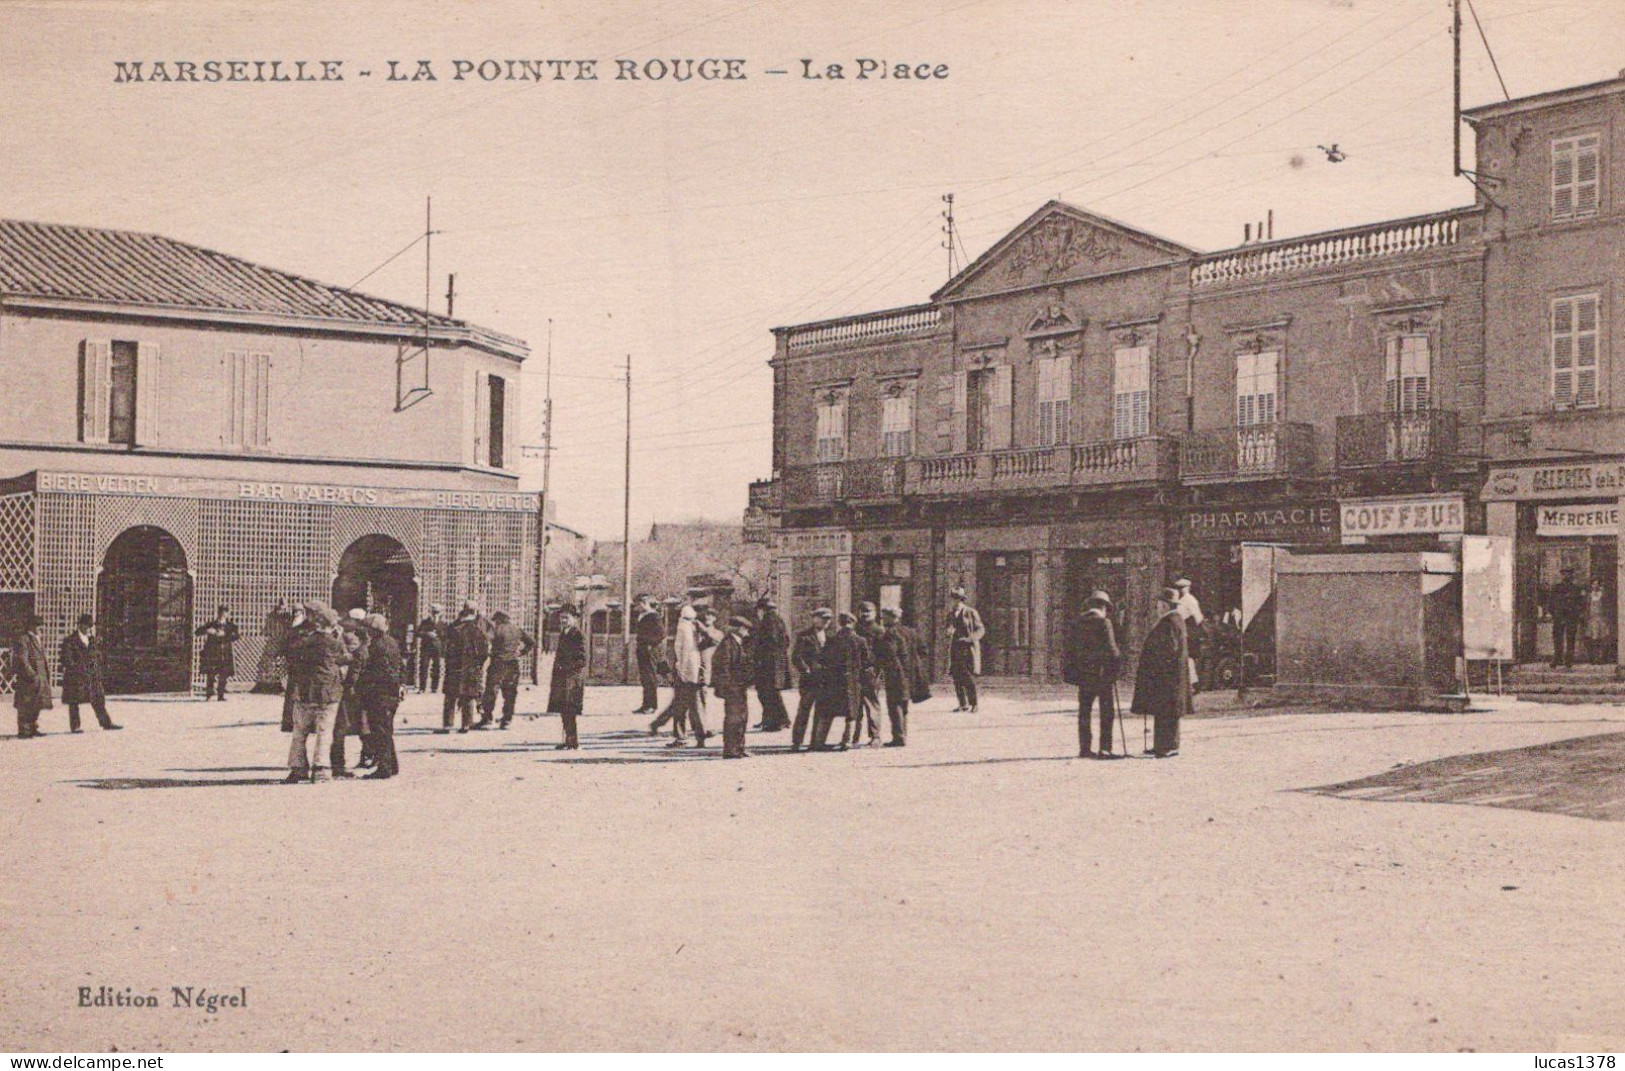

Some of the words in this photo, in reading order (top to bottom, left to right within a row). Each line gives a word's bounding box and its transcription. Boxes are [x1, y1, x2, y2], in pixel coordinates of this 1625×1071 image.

[40, 474, 91, 492] BIERE
[96, 475, 159, 496] VELTEN
[238, 482, 285, 500] BAR
[292, 484, 378, 504] TABACS
[435, 492, 482, 509] BIERE
[485, 493, 540, 512] VELTEN
[1190, 507, 1333, 529] PHARMACIE
[1343, 503, 1461, 530] COIFFEUR
[1542, 509, 1619, 526] MERCERIE
